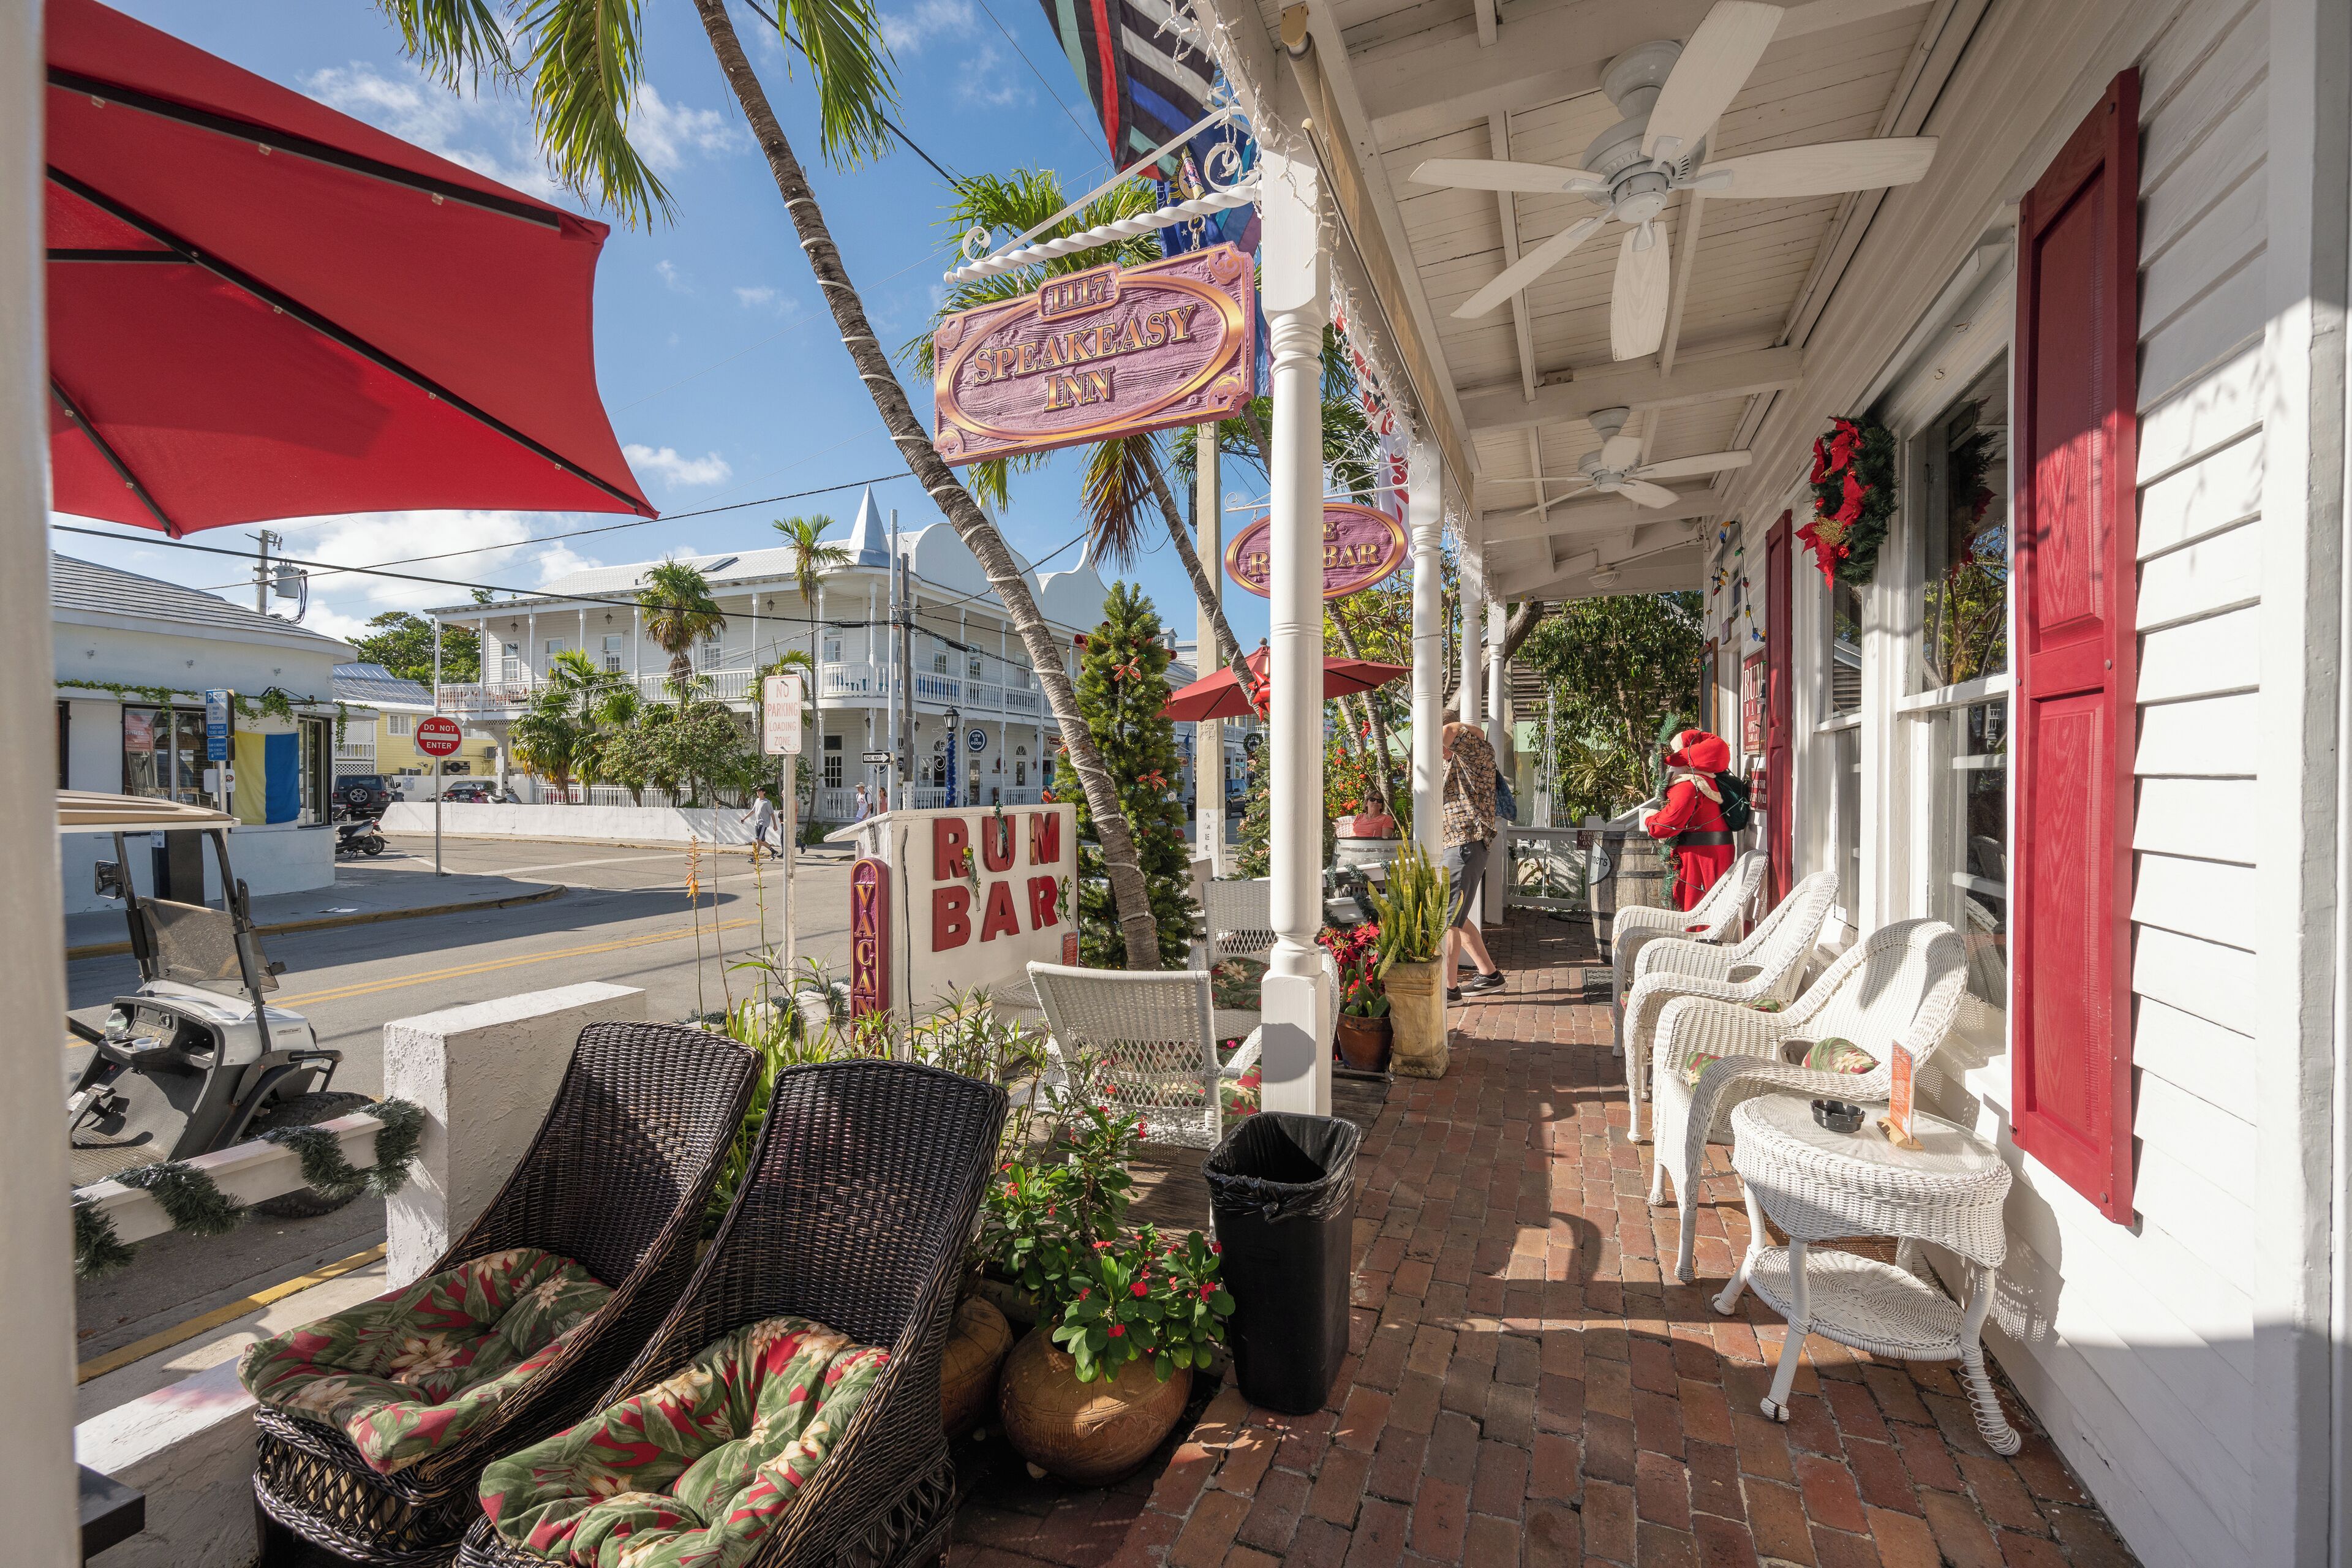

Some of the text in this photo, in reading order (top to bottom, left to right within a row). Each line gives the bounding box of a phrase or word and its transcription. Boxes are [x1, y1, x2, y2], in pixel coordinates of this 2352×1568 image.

[1049, 275, 1109, 314] 1117
[973, 304, 1197, 385] SPEAKEASY
[1044, 367, 1115, 413] INN
[1323, 543, 1381, 570] BAR
[776, 684, 789, 698] NO
[1744, 662, 1763, 702] RUM
[767, 703, 798, 717] PARKING
[769, 722, 796, 732] LOADING
[774, 736, 791, 746] ZONE
[933, 812, 1060, 881] RUM
[932, 875, 1059, 952] BAR
[854, 883, 875, 1019] VACAN
